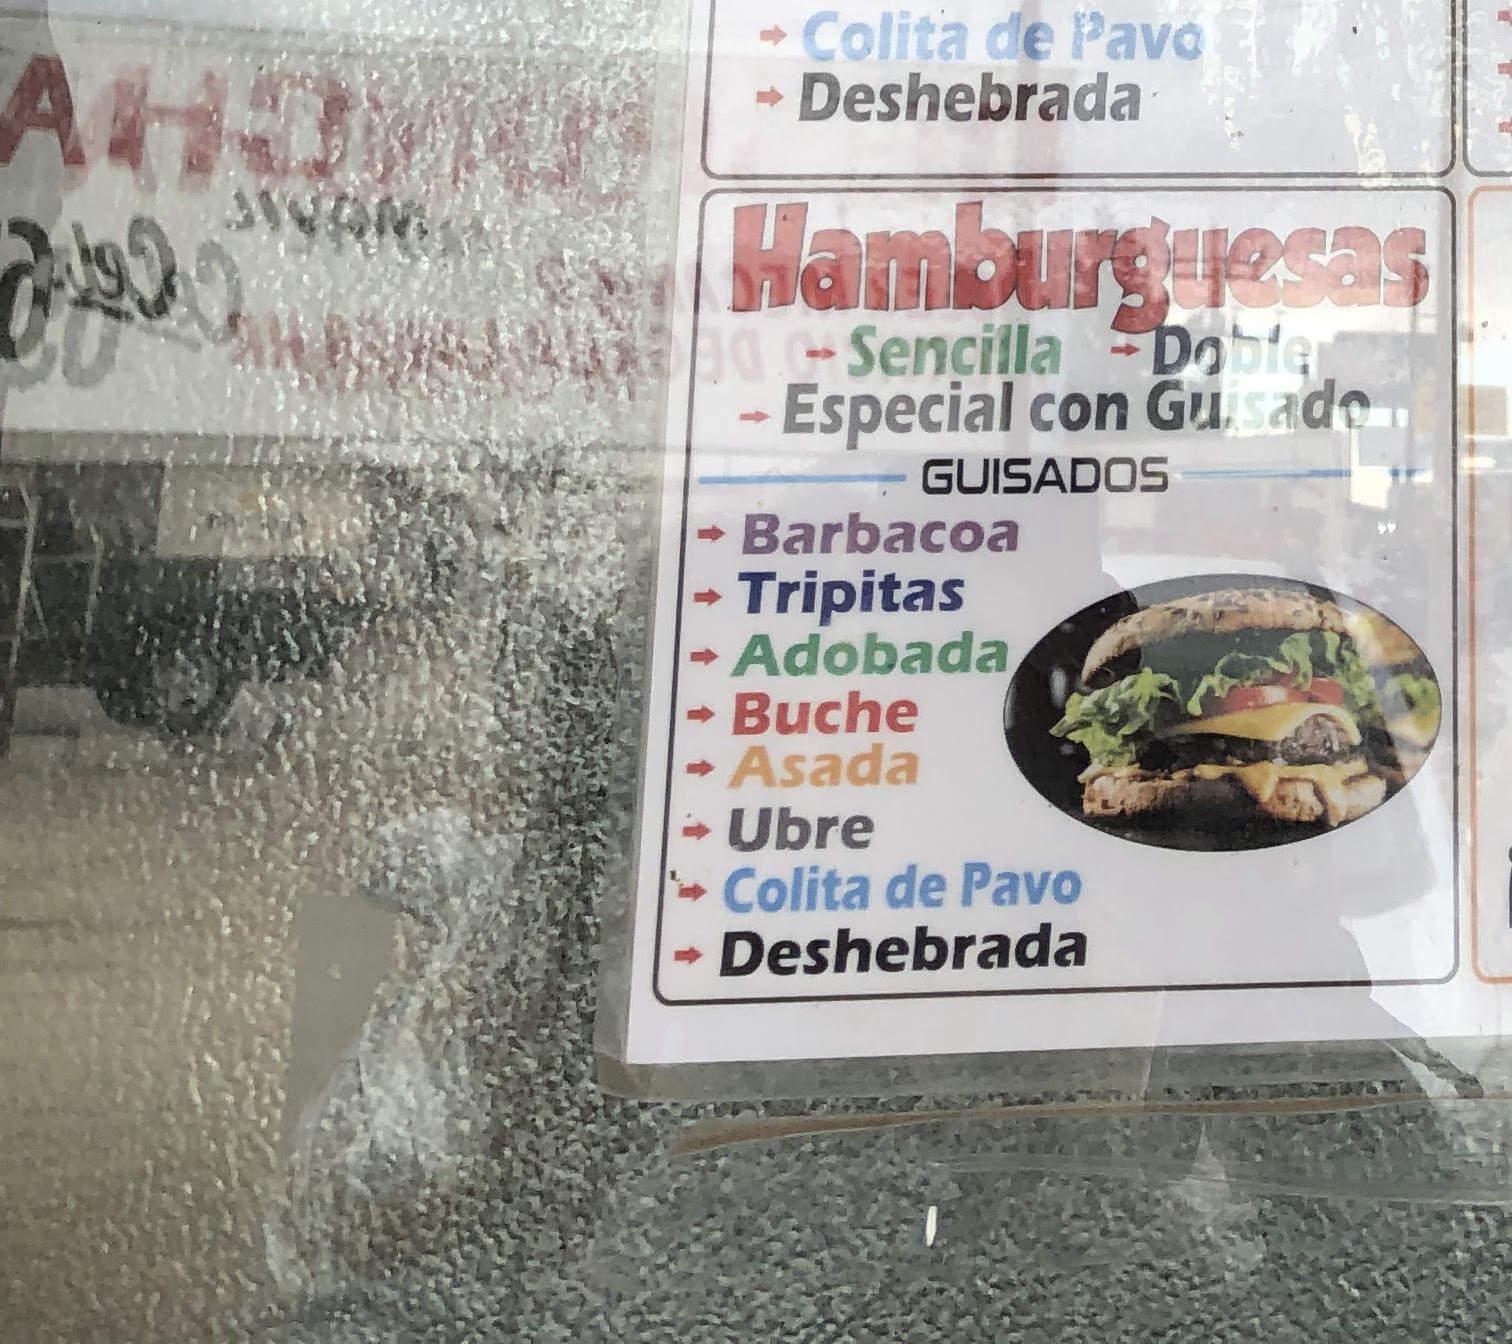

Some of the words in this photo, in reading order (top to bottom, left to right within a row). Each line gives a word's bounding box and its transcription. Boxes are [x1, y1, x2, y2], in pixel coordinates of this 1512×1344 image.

[801, 10, 968, 62] Colita
[985, 12, 1055, 61] de
[1071, 13, 1202, 61] Pavo
[799, 72, 1141, 123] Deshebrada
[731, 201, 1430, 334] Hamburguesas
[847, 323, 1062, 377] Sencilla
[1153, 325, 1312, 376] Doble
[783, 383, 1012, 449] Especial
[1029, 389, 1129, 433] con
[1146, 379, 1370, 432] Guisado
[922, 456, 1169, 496] GUISADOS
[742, 513, 1020, 556] Barbacoa
[738, 571, 965, 626] Tripitas
[730, 630, 1008, 678] Adobada
[731, 692, 918, 737] Buche
[729, 743, 919, 788] Asada
[728, 806, 875, 852] Ubre
[723, 867, 870, 915] Colita
[886, 864, 944, 910] de
[963, 862, 1083, 907] Pavo
[719, 924, 1088, 977] Deshebrada
